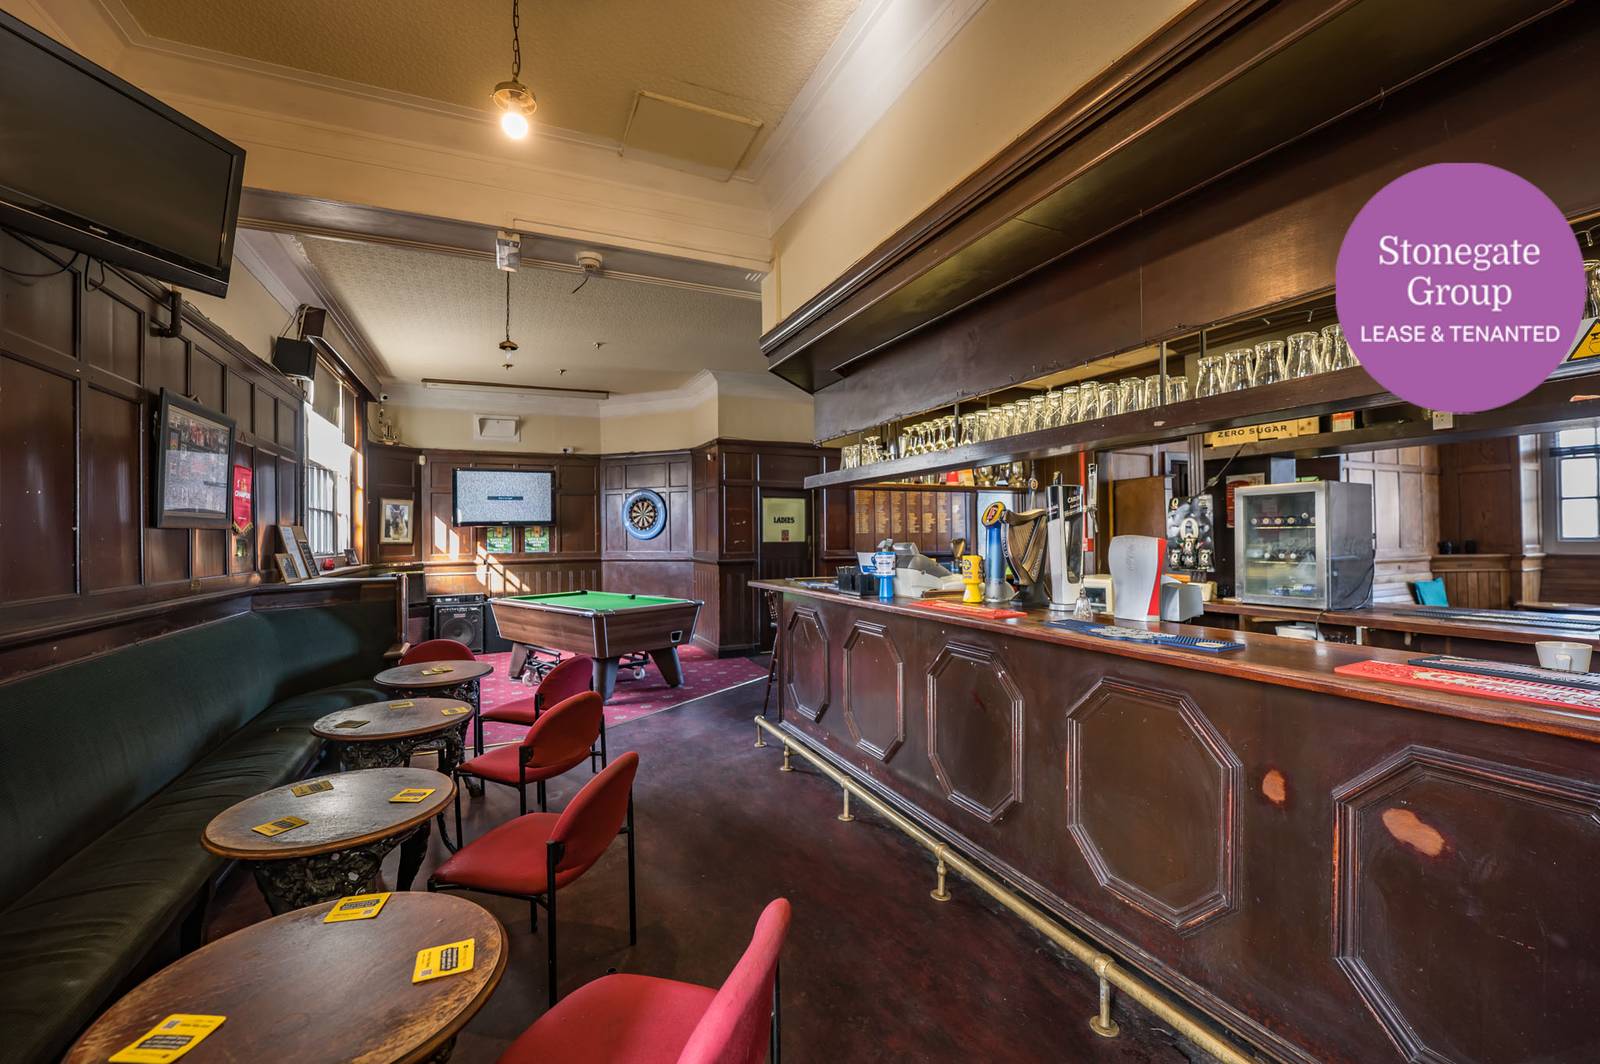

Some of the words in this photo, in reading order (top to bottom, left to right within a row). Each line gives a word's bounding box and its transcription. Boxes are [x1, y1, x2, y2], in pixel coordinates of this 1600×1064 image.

[1217, 428, 1245, 438] ZERO
[1249, 424, 1288, 435] SUGAR
[773, 516, 796, 524] LADIES
